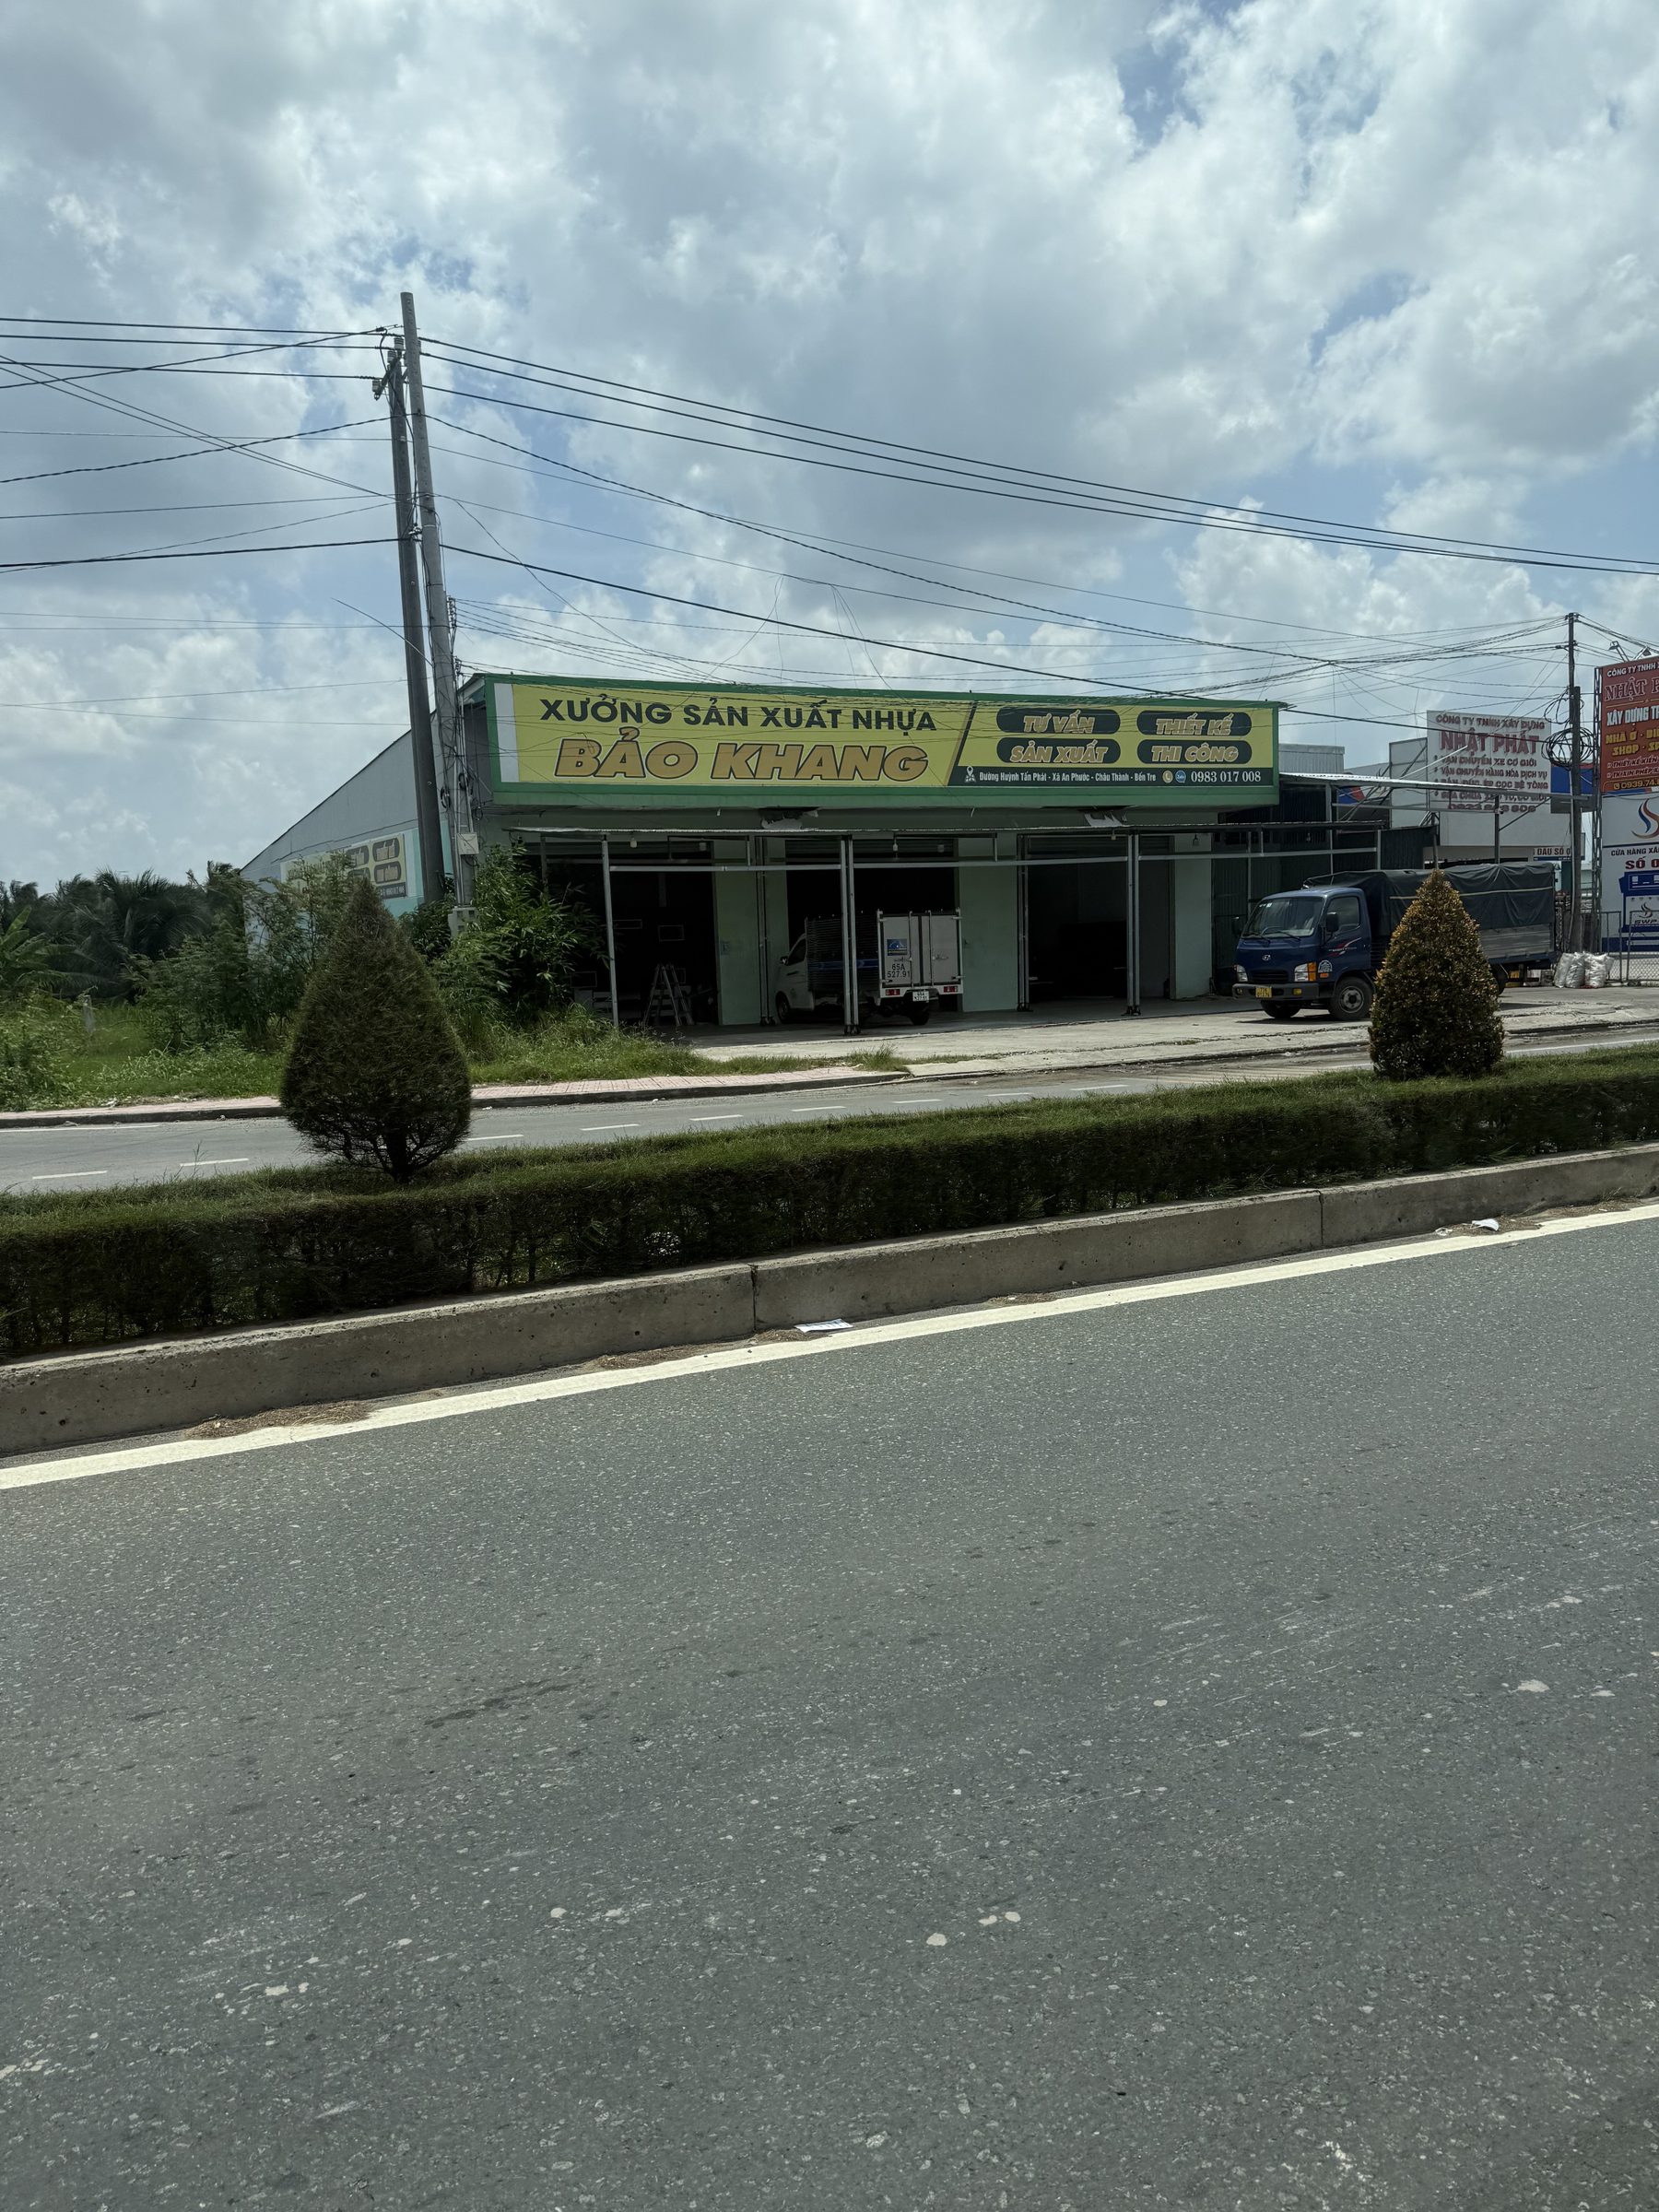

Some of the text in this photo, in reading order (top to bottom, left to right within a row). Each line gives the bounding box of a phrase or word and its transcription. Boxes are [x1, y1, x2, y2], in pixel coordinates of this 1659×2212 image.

[1607, 668, 1626, 677] CÔNG
[1637, 663, 1656, 671] TNHH
[1605, 676, 1647, 701] NHẬT
[540, 693, 936, 735] XƯỞNG SẢN XUẤT NHỰA
[1022, 709, 1095, 734] TƯ VẤN
[1156, 712, 1234, 735] THIẾT KẾ
[1463, 717, 1475, 725] TY
[1607, 709, 1623, 726] XÂY
[1624, 706, 1649, 726] DỰNG
[1010, 740, 1109, 763] SẢN XUẤT
[1441, 727, 1539, 756] NHẬT PHÁT
[1612, 744, 1639, 755] SHOP
[554, 727, 928, 782] BẢO KHANG
[1151, 742, 1239, 763] THI CÔNG
[979, 771, 999, 782] Đường
[1000, 771, 1019, 782] Huỳnh
[1020, 771, 1031, 781] Tấn
[1033, 771, 1047, 781] Phát
[1062, 772, 1070, 781] An
[1071, 771, 1090, 781] Phước
[1095, 771, 1110, 781] Châu
[1112, 771, 1129, 781] Thành
[1134, 771, 1146, 781] Bến
[1147, 773, 1156, 781] Tre
[1191, 771, 1261, 782] 0983 017 008
[1626, 847, 1646, 856] HÀNG
[1625, 856, 1646, 870] SỐ
